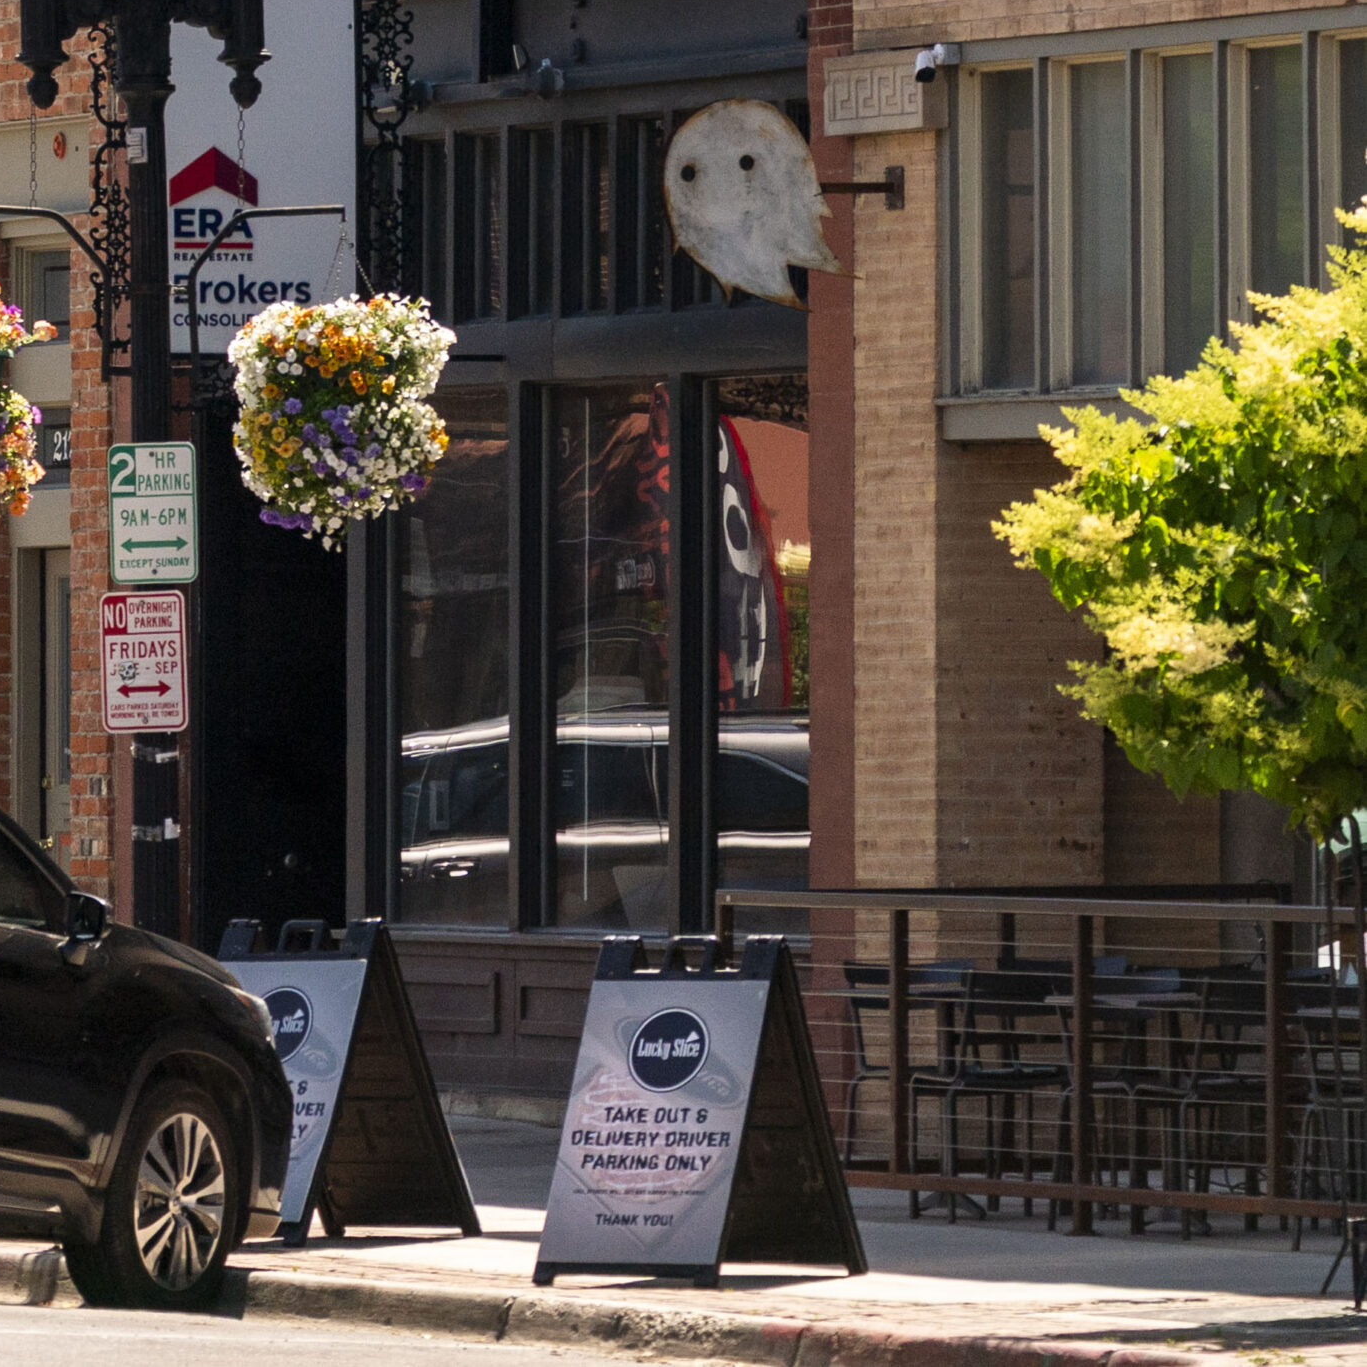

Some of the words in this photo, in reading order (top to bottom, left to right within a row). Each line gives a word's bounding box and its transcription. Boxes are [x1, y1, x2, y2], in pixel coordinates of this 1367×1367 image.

[174, 253, 200, 261] REA
[209, 253, 253, 261] ESTATE
[52, 430, 71, 462] 21
[111, 452, 135, 493] 2
[155, 452, 176, 469] HR
[138, 473, 191, 491] PARKING
[119, 557, 153, 569] EXCEPT
[155, 556, 190, 567] SUNDAY
[104, 602, 127, 630] NO
[128, 601, 178, 615] OVERNIGHT
[134, 615, 173, 629] PARKING
[109, 640, 177, 659] FRIDAYS
[155, 661, 178, 675] SEP
[636, 1037, 672, 1061] Lucky
[672, 1037, 701, 1058] Slice
[603, 1106, 650, 1124] TAKE
[653, 1106, 692, 1124] OUT
[695, 1108, 709, 1124] &
[570, 1129, 660, 1147] DELIVERY
[664, 1131, 731, 1148] DRIVER
[580, 1153, 659, 1171] PARKING
[664, 1154, 713, 1172] ONLY
[595, 1213, 640, 1227] THANK
[642, 1214, 674, 1228] YOU!
